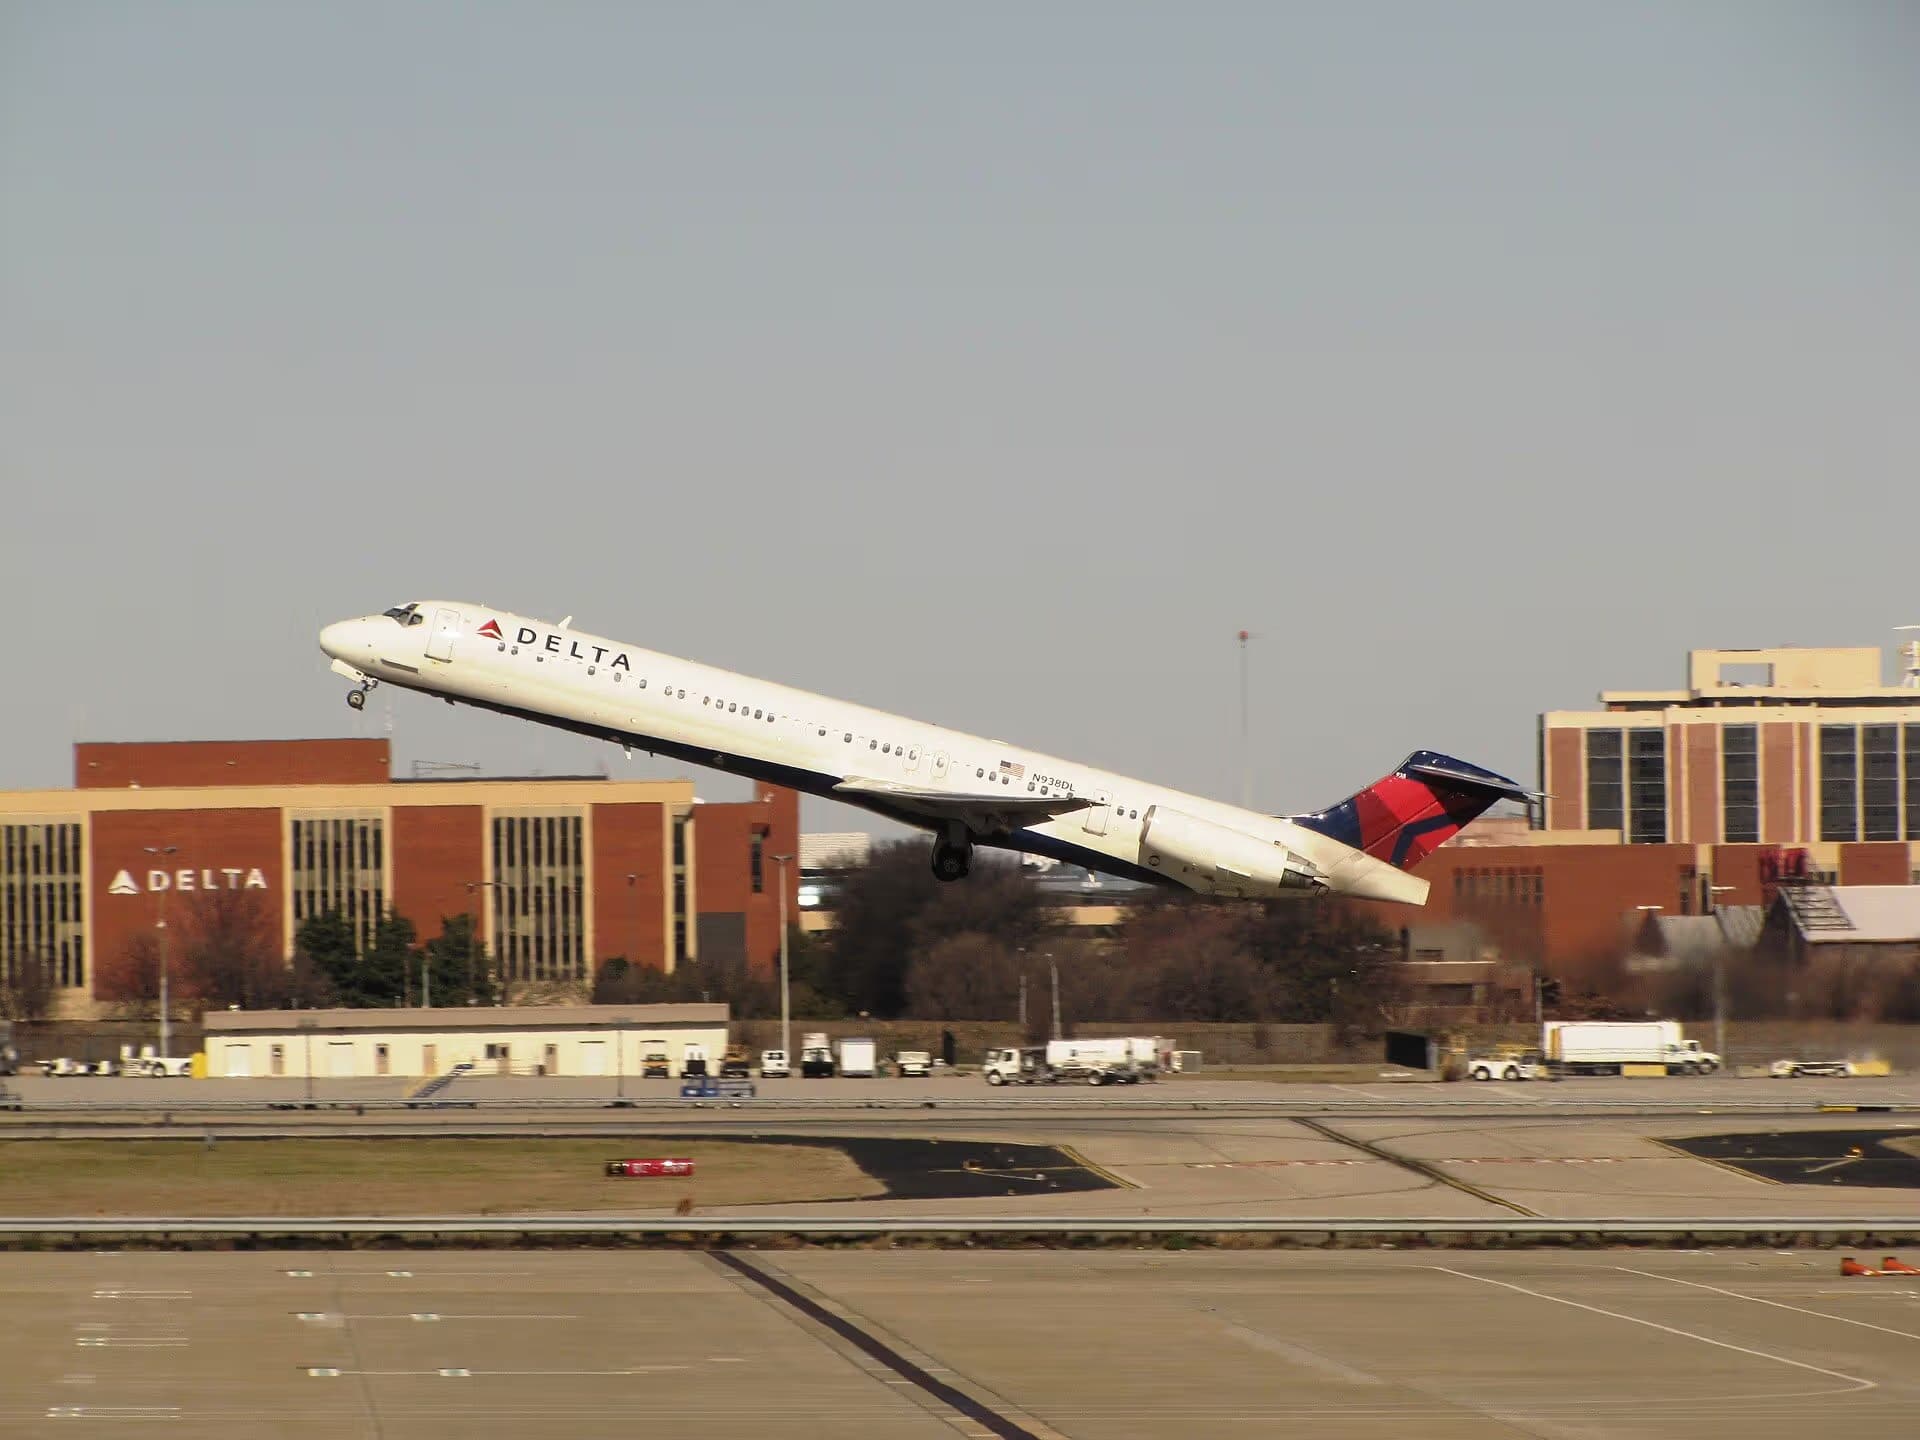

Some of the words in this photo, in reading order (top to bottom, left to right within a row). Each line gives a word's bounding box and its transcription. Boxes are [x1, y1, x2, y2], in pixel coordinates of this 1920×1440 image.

[517, 627, 630, 671] DELTA
[1032, 773, 1075, 792] N938DL
[147, 868, 268, 892] DELTA
